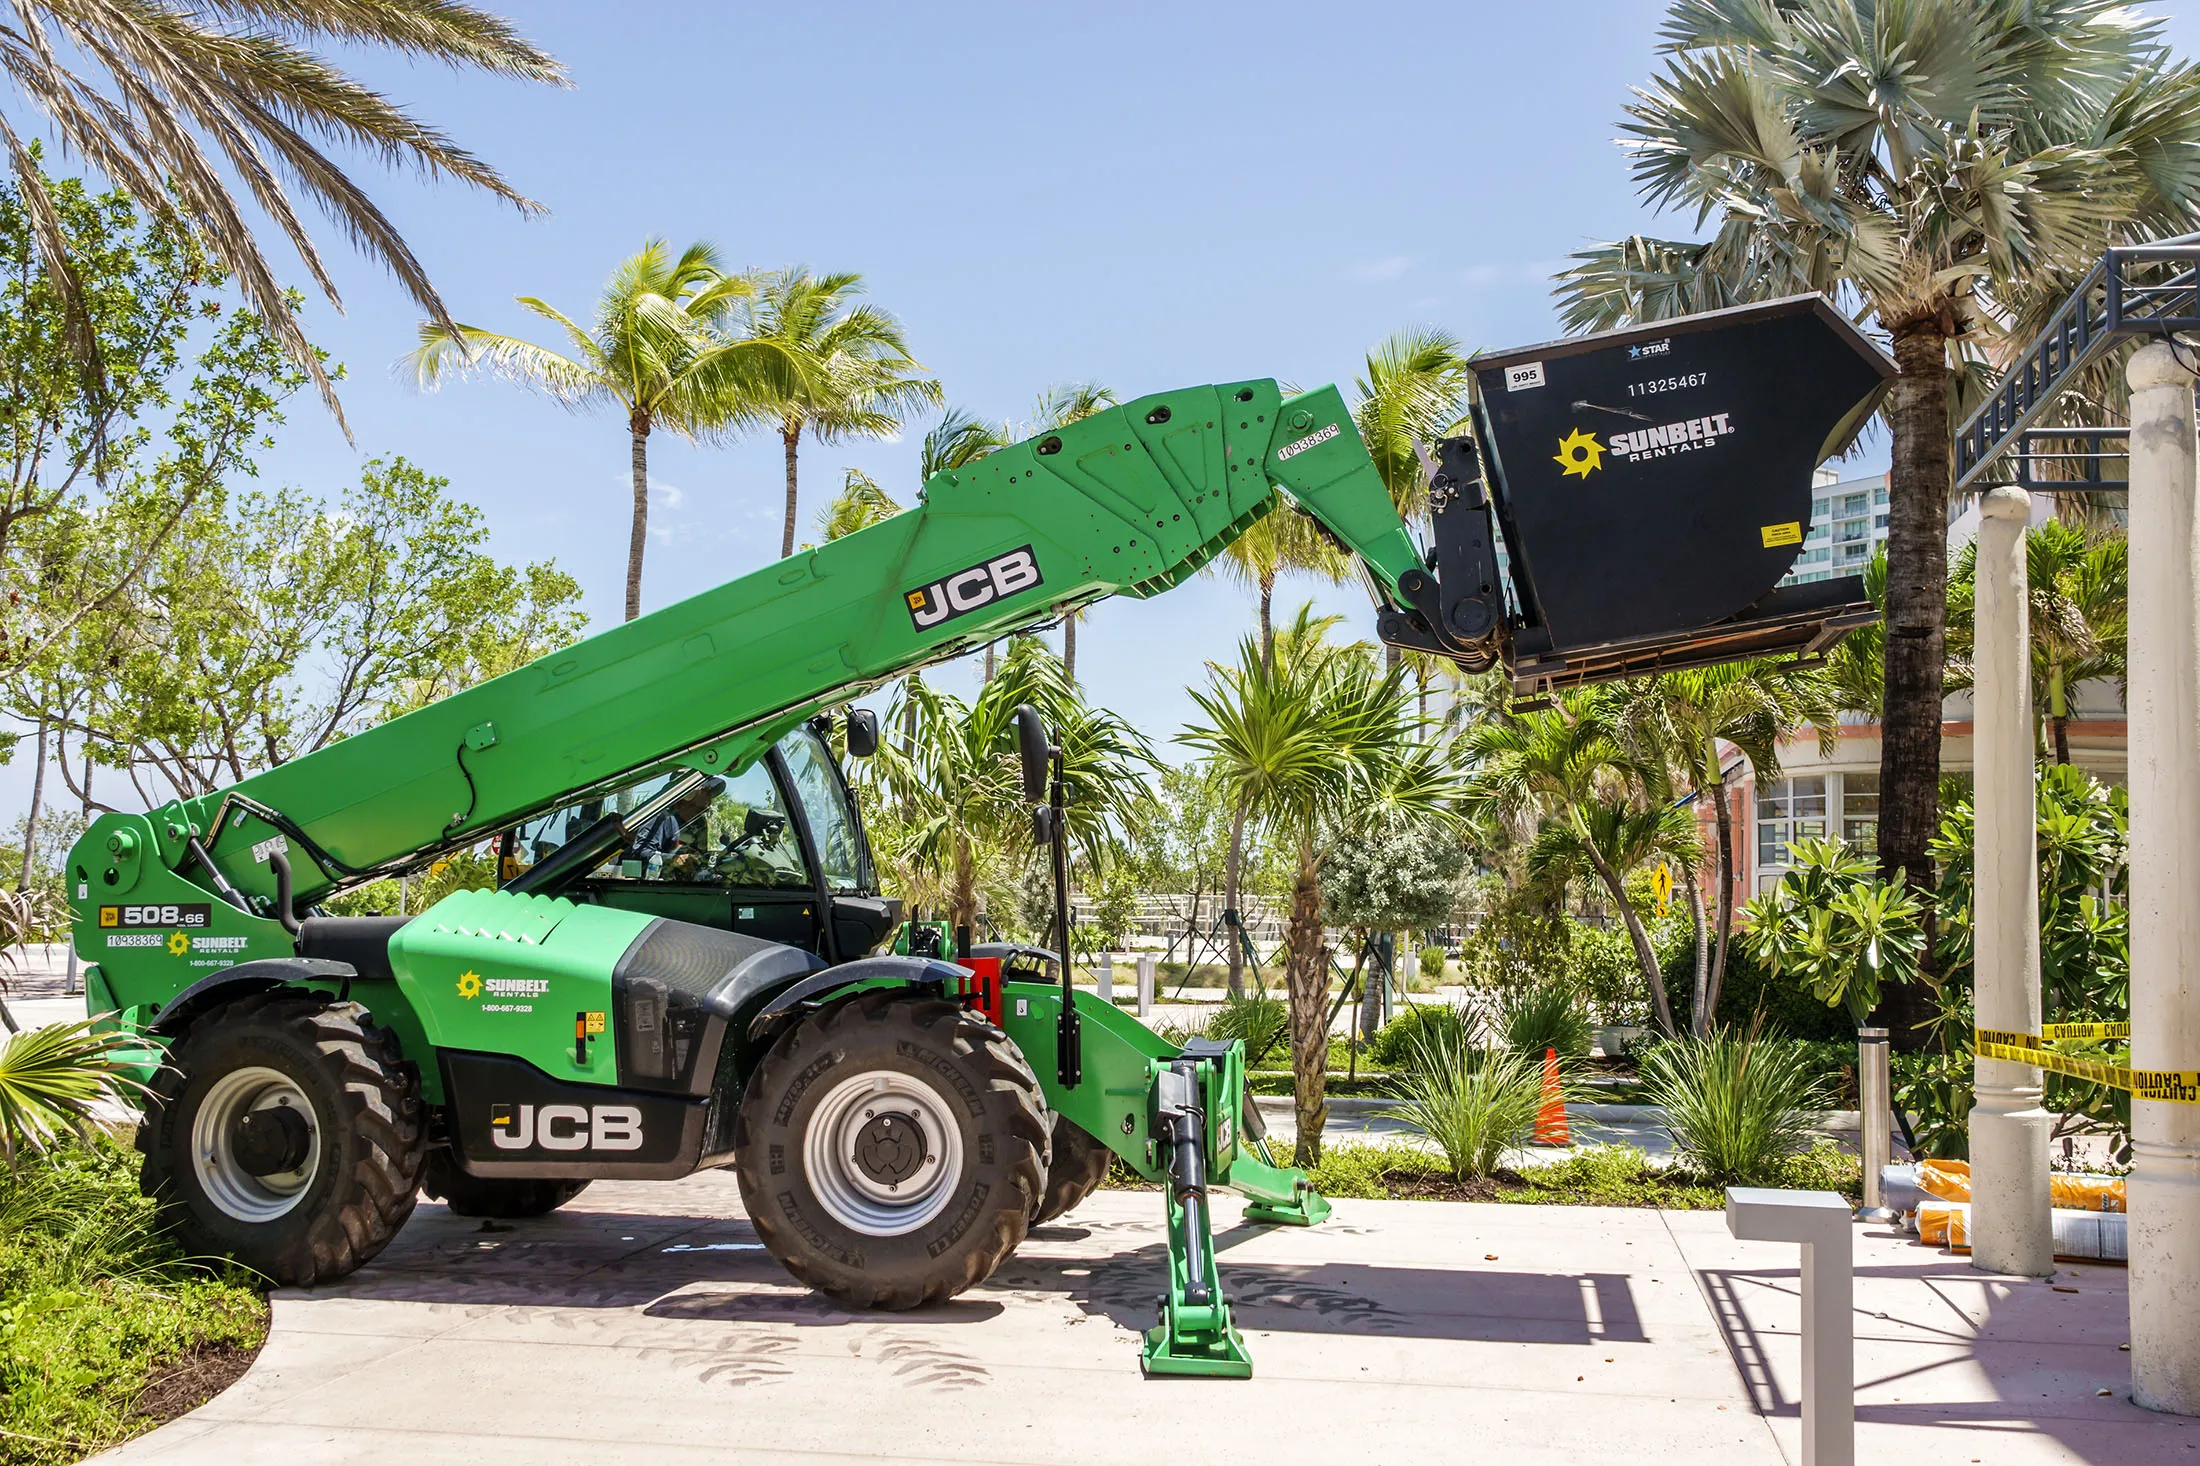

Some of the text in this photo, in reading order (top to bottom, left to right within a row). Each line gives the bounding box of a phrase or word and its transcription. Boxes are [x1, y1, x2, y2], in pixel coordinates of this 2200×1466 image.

[1641, 343, 1670, 356] STAR
[1513, 369, 1538, 383] 995
[1627, 372, 1708, 398] 11325467
[1278, 423, 1340, 460] 10938369
[1608, 412, 1730, 457] SUNBELT
[1629, 437, 1717, 463] RENTALS
[914, 551, 1038, 626] JCB
[108, 936, 163, 946] 10938369
[192, 937, 247, 949] SUNBELT
[485, 979, 549, 993] SUNBELT
[481, 1004, 533, 1013] 1-800-667-9328
[2133, 1071, 2182, 1089] CAUTION
[492, 1104, 644, 1151] JCB
